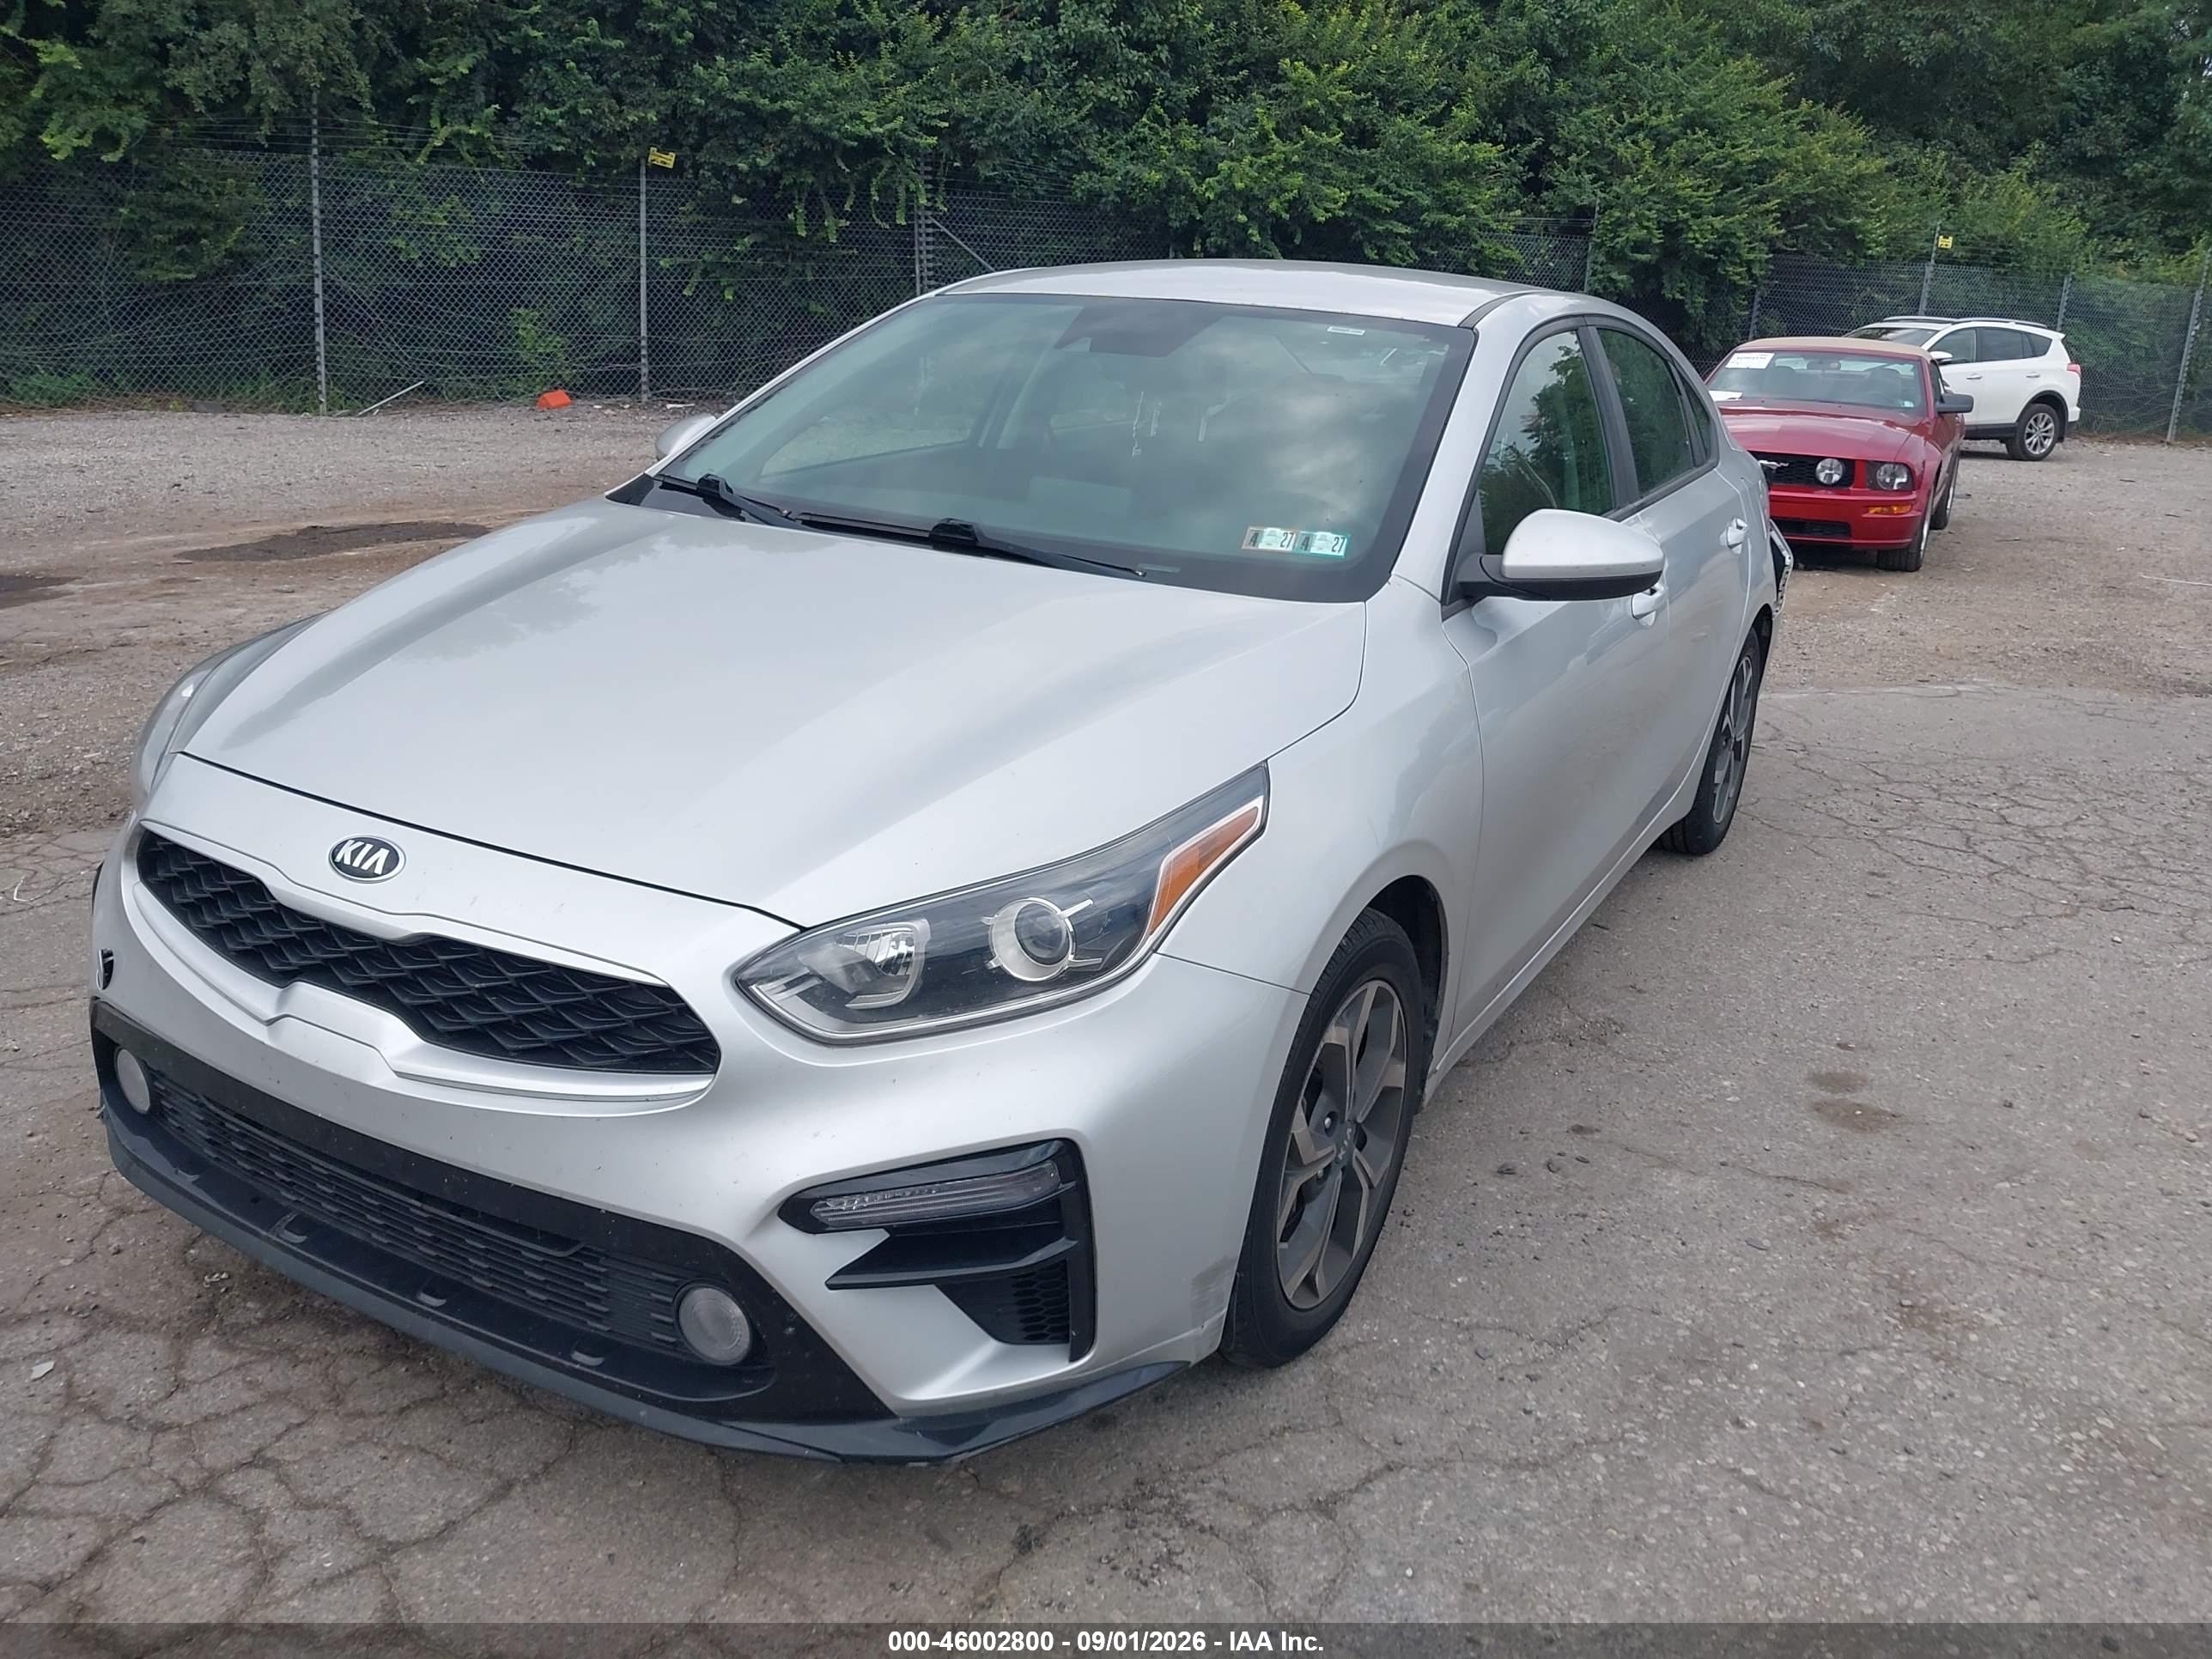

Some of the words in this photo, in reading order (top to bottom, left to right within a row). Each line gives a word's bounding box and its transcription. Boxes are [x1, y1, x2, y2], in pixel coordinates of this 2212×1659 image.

[1249, 532, 1260, 548] 4
[1279, 532, 1294, 549] 27
[1300, 536, 1310, 551] 4
[1331, 536, 1346, 553] 27
[334, 839, 390, 875] KIA
